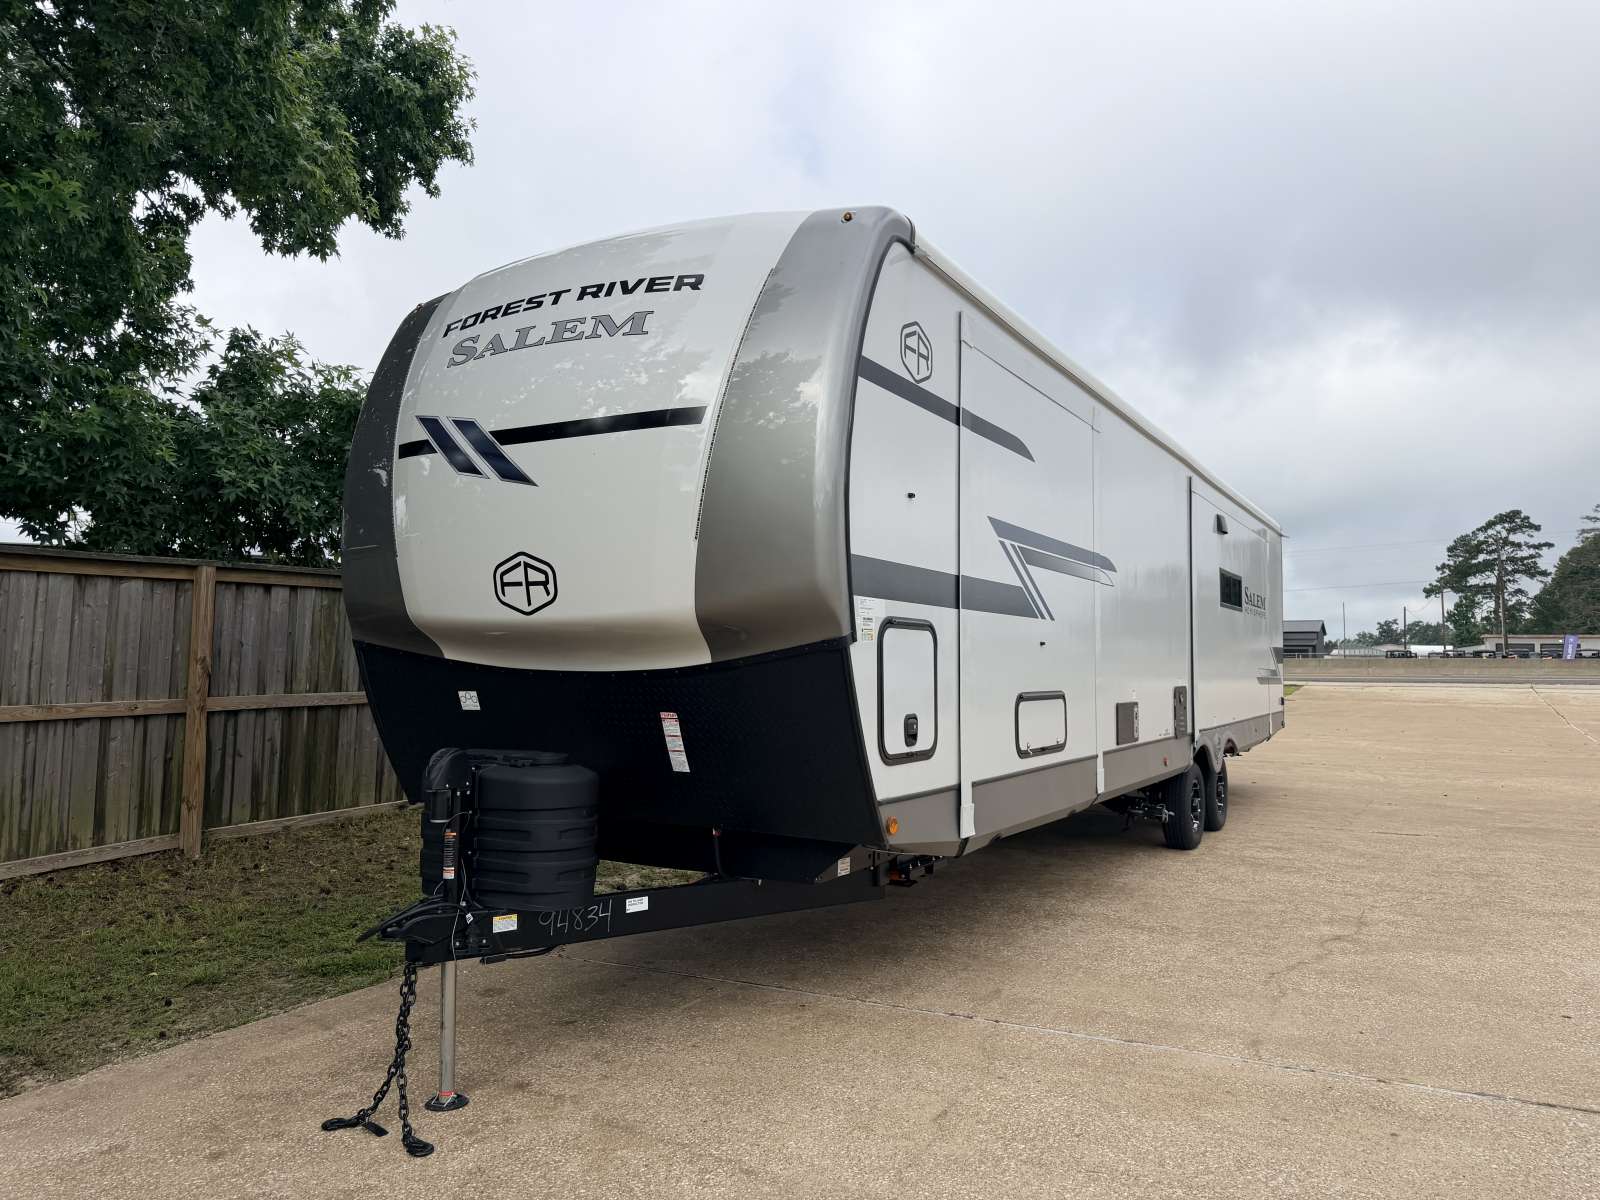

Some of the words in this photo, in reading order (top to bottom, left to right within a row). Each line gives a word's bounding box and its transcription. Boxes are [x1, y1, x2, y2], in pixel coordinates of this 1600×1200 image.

[442, 288, 571, 338] FOREST
[576, 273, 705, 302] RIVER
[446, 310, 655, 369] SALEM
[500, 560, 551, 607] FR
[538, 898, 613, 936] 94834
